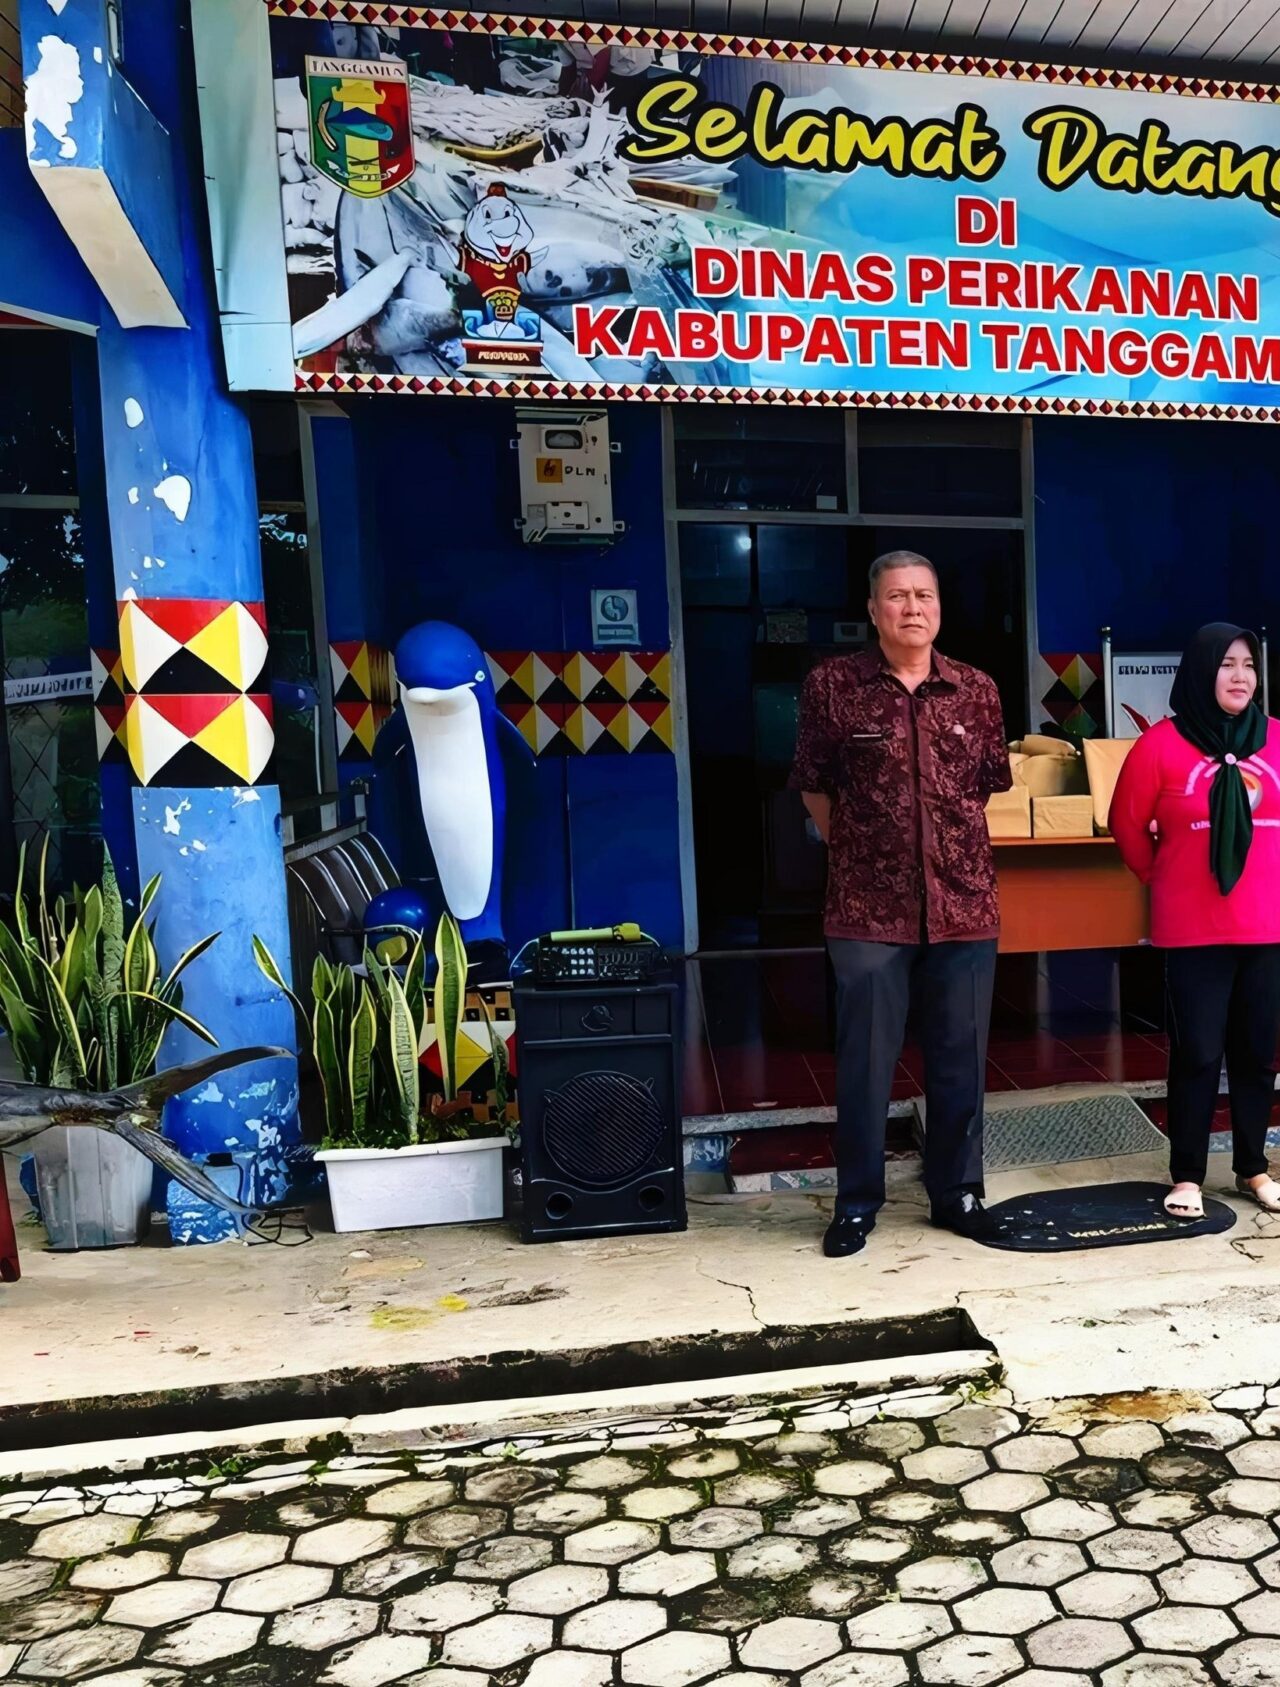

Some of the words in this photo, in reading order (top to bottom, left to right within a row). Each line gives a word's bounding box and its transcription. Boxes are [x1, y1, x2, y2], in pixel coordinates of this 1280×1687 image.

[626, 80, 1000, 177] Selamat
[958, 198, 1016, 247] DI
[694, 247, 895, 304] DINAS
[908, 257, 1258, 322] PERIKANAN
[576, 306, 970, 369] KABUPATEN
